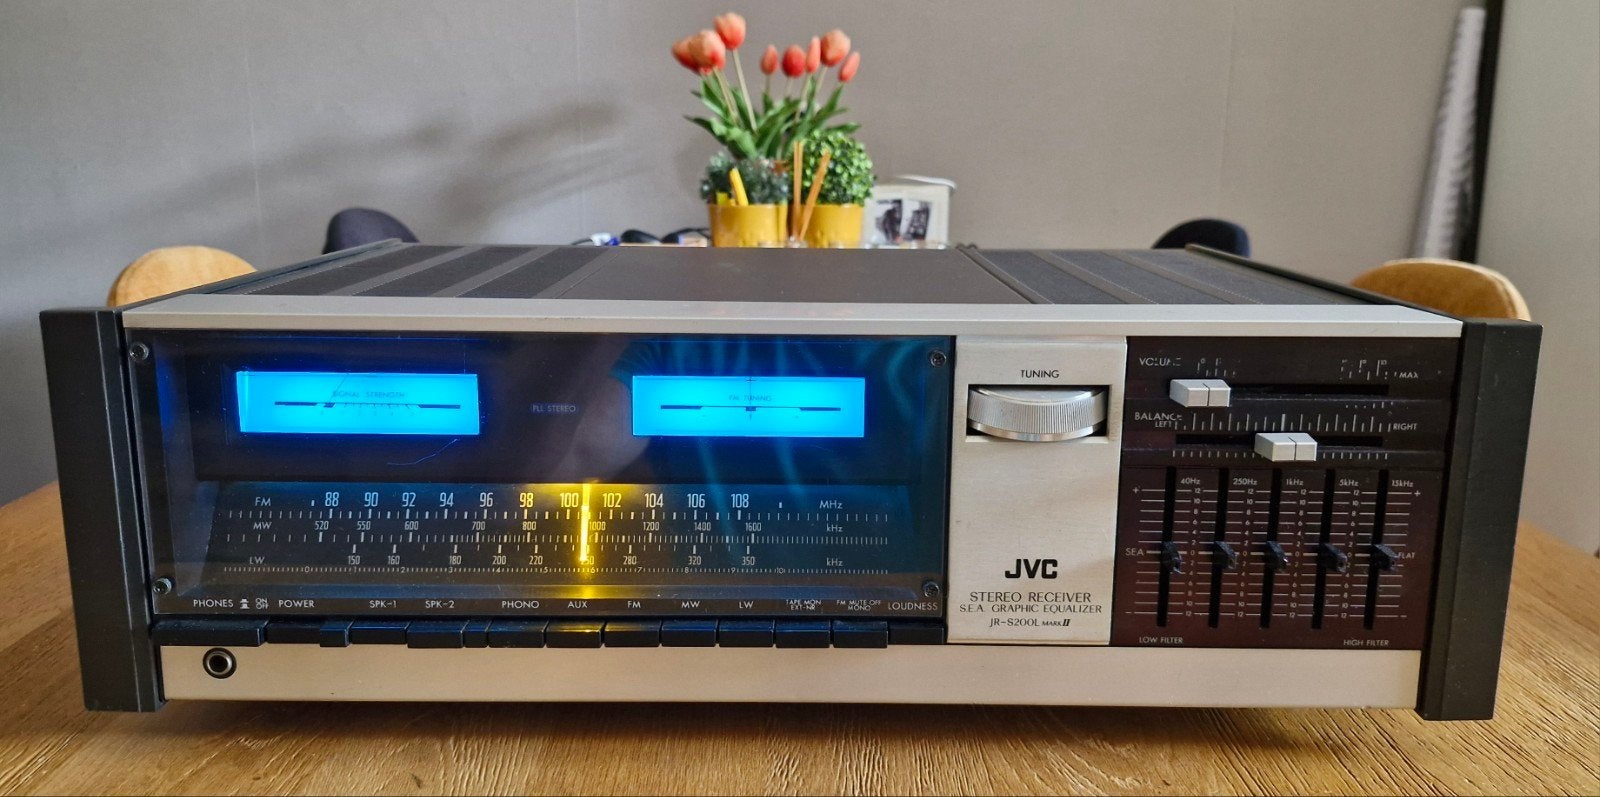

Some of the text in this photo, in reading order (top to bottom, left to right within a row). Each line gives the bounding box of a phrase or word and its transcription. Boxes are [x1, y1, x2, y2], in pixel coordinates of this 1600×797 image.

[1021, 370, 1060, 378] TUNING
[1134, 412, 1182, 420] BALANCE
[255, 492, 842, 509] FM 88 90 92 94 96 98 100 102 104 106 108 MHz
[253, 521, 842, 532] MW 520 550 600 700 800 1000 1200 1400 1600 kHz
[250, 556, 264, 564] LW
[348, 556, 360, 565] 150
[388, 556, 400, 565] 160
[450, 556, 461, 565] 180
[492, 556, 506, 565] 200
[529, 556, 543, 565] 220
[623, 556, 637, 565] 280
[688, 556, 701, 565] 320
[742, 556, 755, 565] 350
[826, 558, 842, 566] kHz
[1005, 559, 1057, 579] JVC
[970, 592, 1091, 603] STEREO RECEIVER
[193, 599, 234, 608] PHONES
[278, 600, 314, 608] POWER
[369, 600, 396, 608] SPK-1
[425, 600, 454, 608] SPK-2
[501, 600, 539, 609] PHONO
[567, 600, 588, 609] AUX
[888, 602, 938, 611] LOUDNESS
[992, 604, 1038, 613] GRAPHIC
[1044, 605, 1102, 614] EQUALIZER
[989, 618, 1039, 627] JR-S200L
